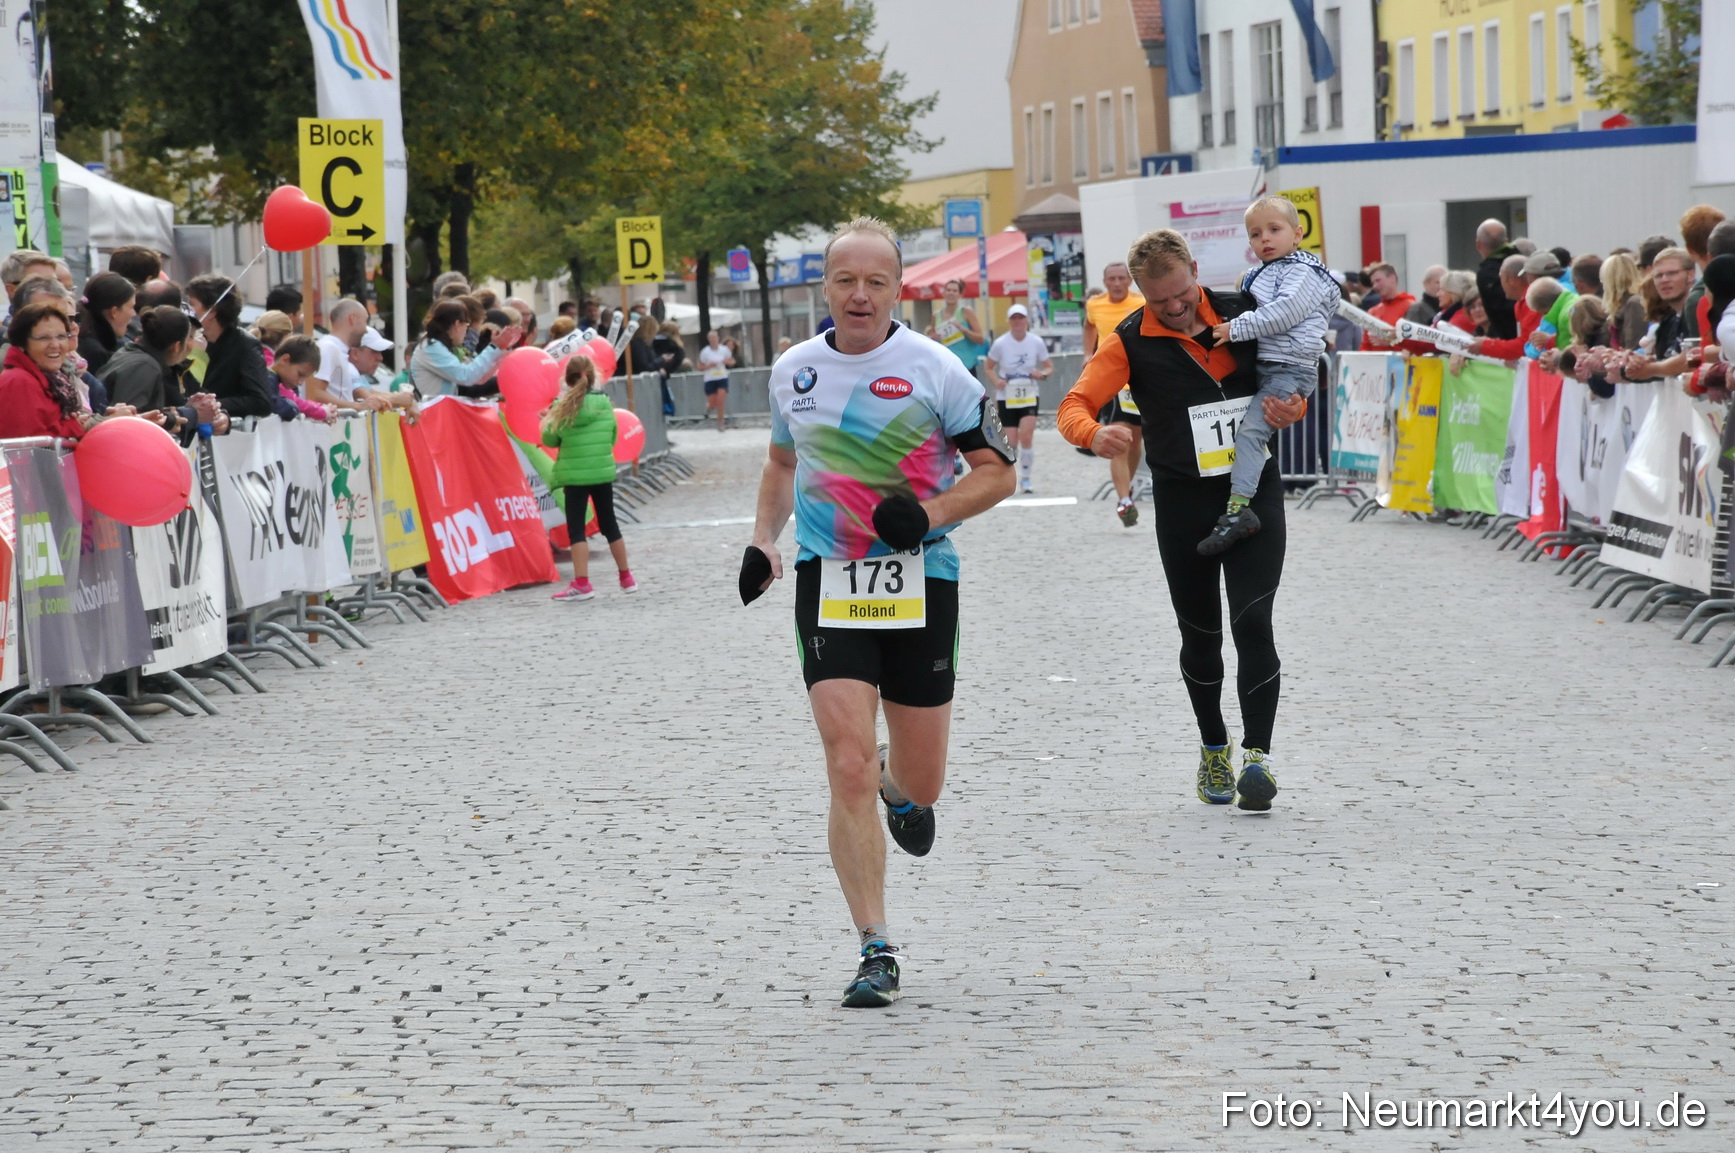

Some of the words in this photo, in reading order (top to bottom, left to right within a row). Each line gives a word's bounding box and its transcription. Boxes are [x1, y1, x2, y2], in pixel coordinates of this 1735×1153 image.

[309, 124, 374, 146] Block
[321, 157, 364, 218] C
[622, 220, 656, 233] Block
[629, 238, 652, 269] D
[1416, 327, 1440, 341] BMW
[1015, 388, 1027, 399] 31
[792, 397, 817, 407] PARTL
[792, 405, 817, 414] Neumarkt
[1192, 410, 1219, 421] PARTL
[1210, 417, 1244, 447] 11
[842, 560, 904, 594] 173
[849, 603, 896, 618] Roland
